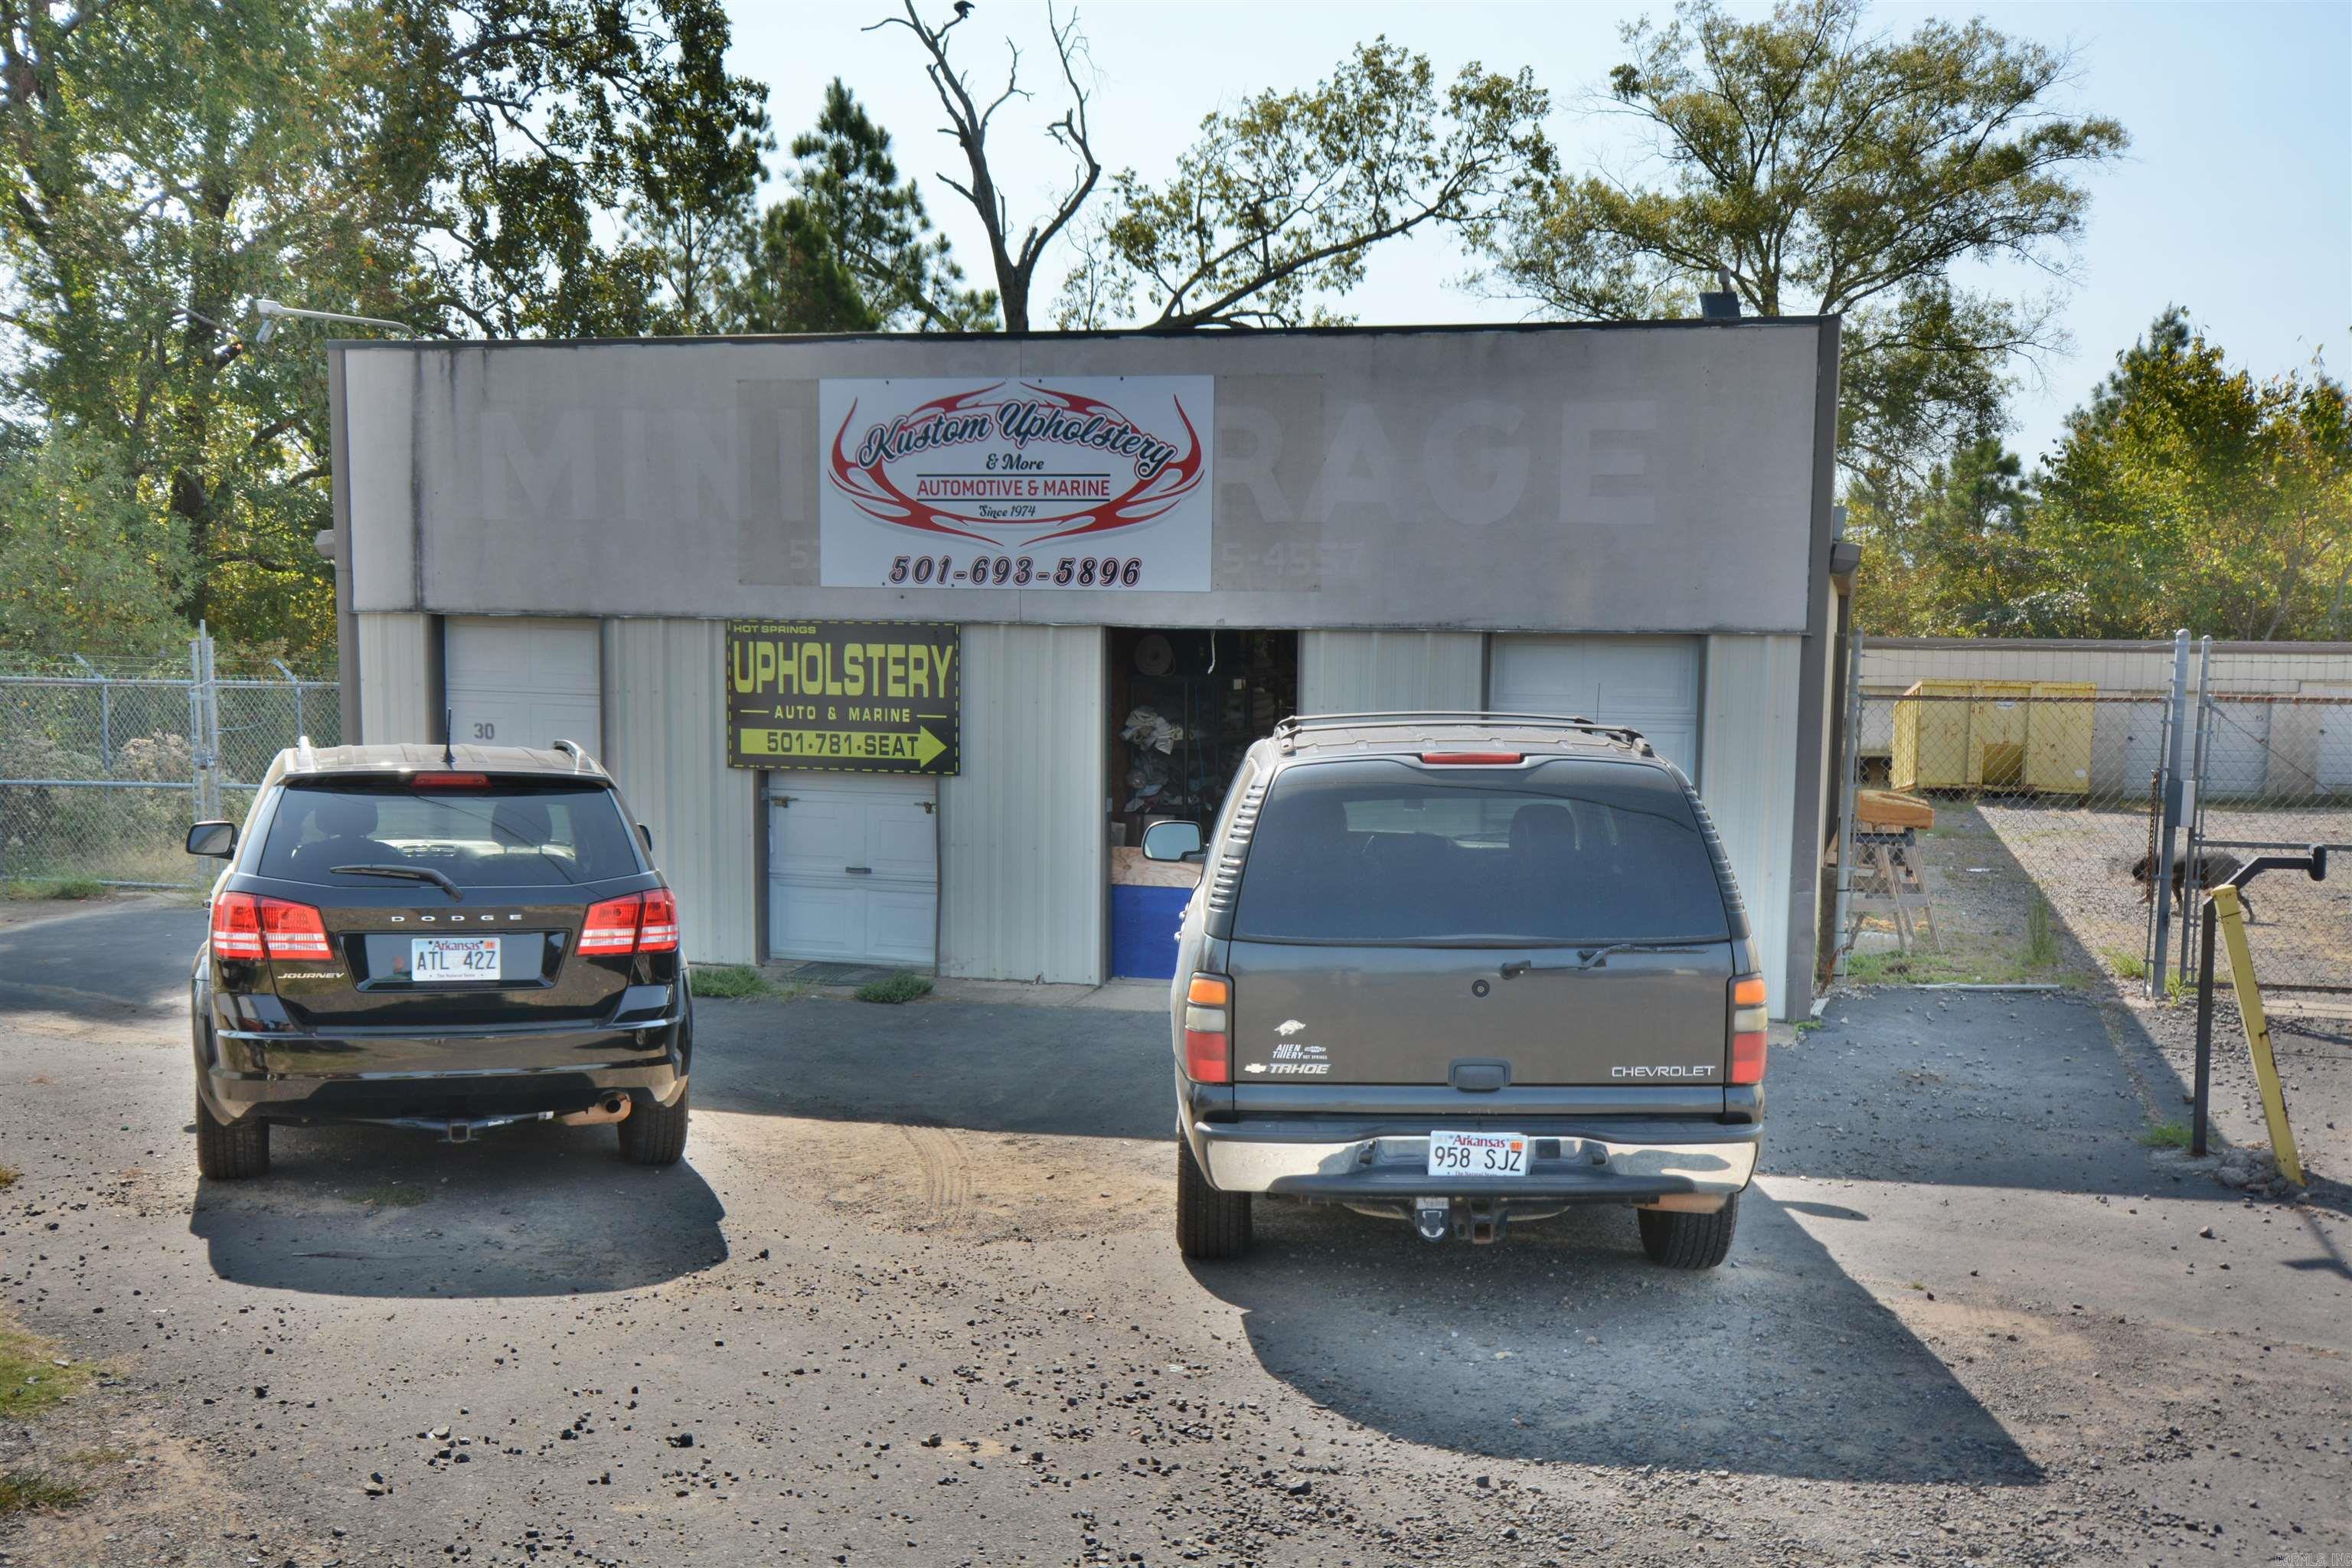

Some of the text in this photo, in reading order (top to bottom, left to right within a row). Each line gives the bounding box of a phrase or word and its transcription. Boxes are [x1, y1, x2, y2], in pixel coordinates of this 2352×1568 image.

[858, 400, 1177, 479] Kustom Upholstery
[985, 453, 1044, 471] & More
[916, 480, 1110, 497] AUTOMOTIVE & MARINE
[978, 505, 1037, 518] Since 1974
[889, 556, 1142, 586] 501-693-5896
[733, 624, 817, 635] HOT SPRINGS
[733, 641, 953, 698] UPHOLSTERY
[774, 705, 910, 722] AUTO & MARINE
[474, 723, 495, 740] 30
[433, 940, 480, 950] Arkansas
[417, 951, 496, 970] ATL 42Z
[1269, 1063, 1332, 1073] TAHOE
[1612, 1066, 1716, 1076] CHEVROLET
[1453, 1135, 1506, 1148] Arkansas
[1435, 1146, 1522, 1171] 958 SJZ
